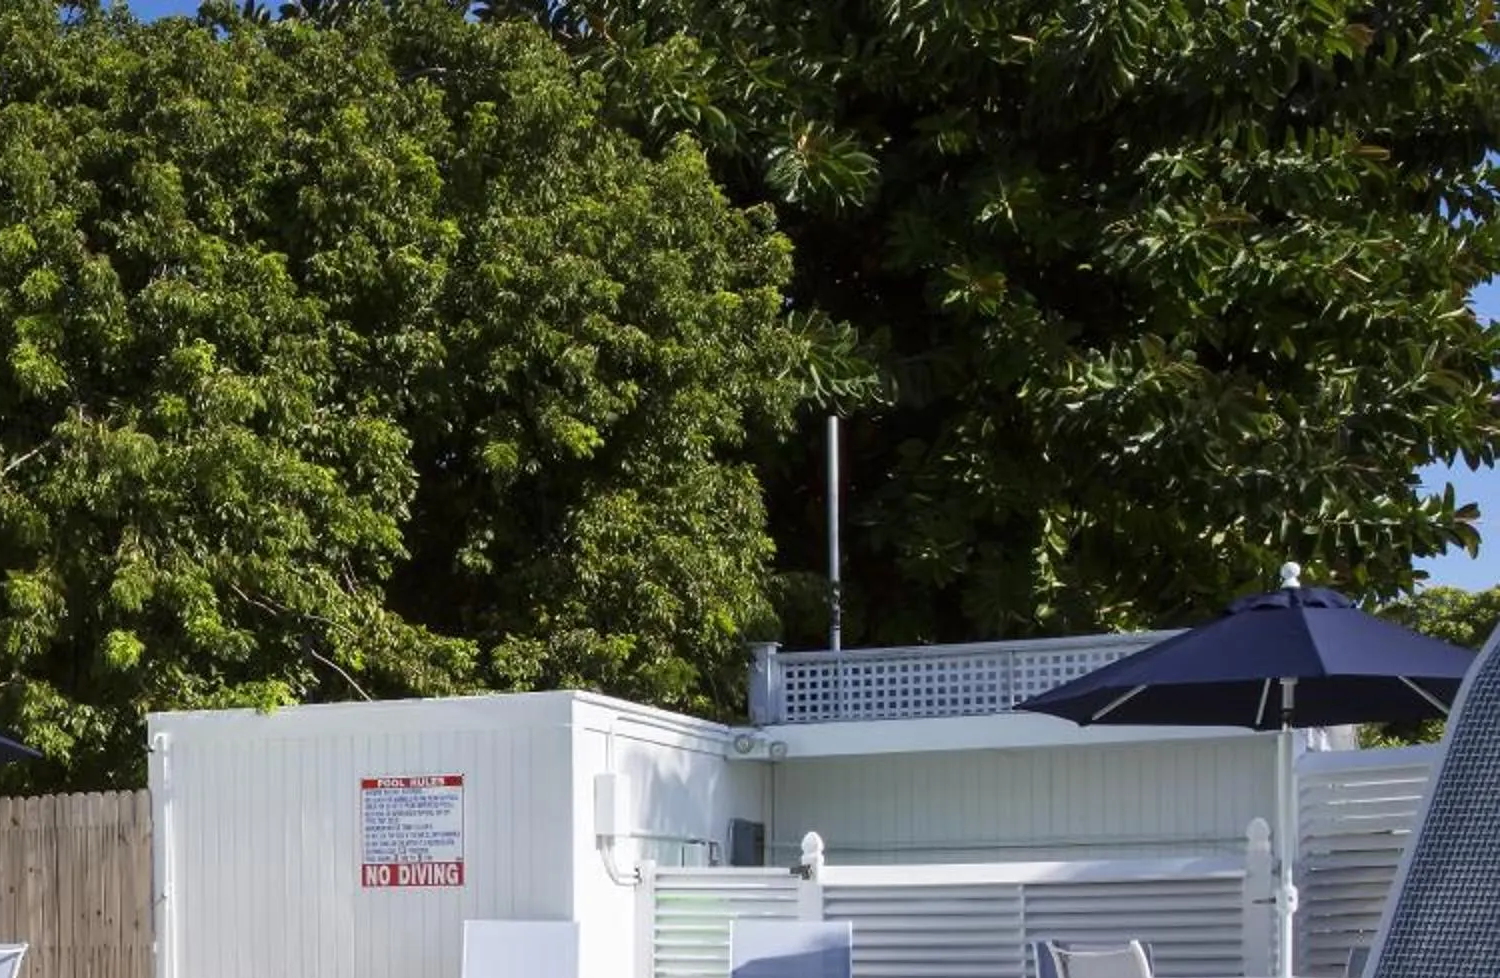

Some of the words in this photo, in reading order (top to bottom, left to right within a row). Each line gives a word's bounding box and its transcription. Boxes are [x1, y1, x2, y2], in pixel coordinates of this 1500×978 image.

[377, 778, 405, 788] POOL
[365, 865, 391, 886] NO
[398, 863, 460, 885] DIVING
